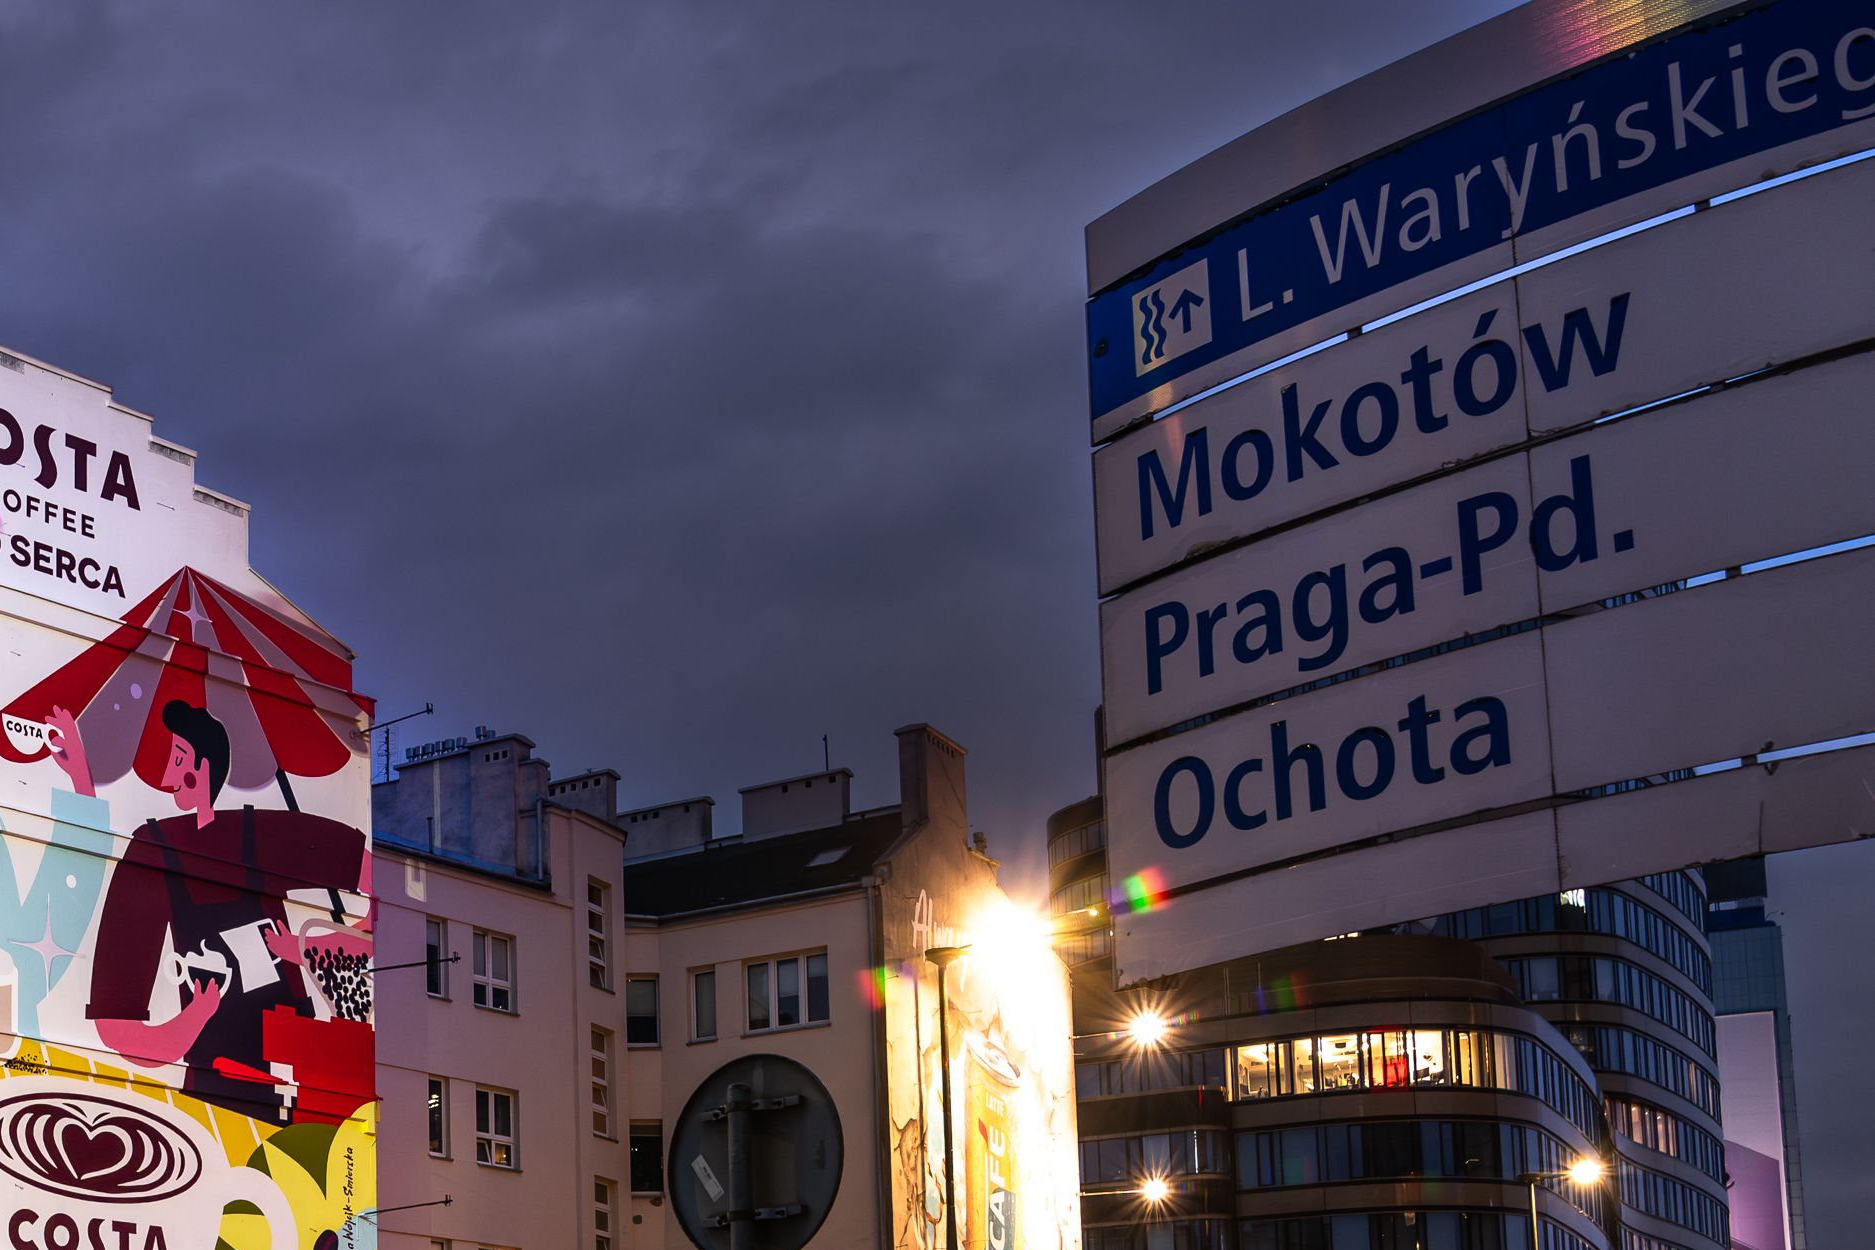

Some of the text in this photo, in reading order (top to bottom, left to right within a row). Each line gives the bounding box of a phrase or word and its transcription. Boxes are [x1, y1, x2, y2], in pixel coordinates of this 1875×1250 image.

[1239, 247, 1294, 323] L.
[1137, 292, 1631, 541] Mokotów
[9, 534, 126, 599] SERCA
[1143, 455, 1635, 696] Praga-Pd.
[5, 719, 44, 741] COSTA
[1153, 694, 1512, 849] Ochota
[985, 1092, 1005, 1117] LATTE
